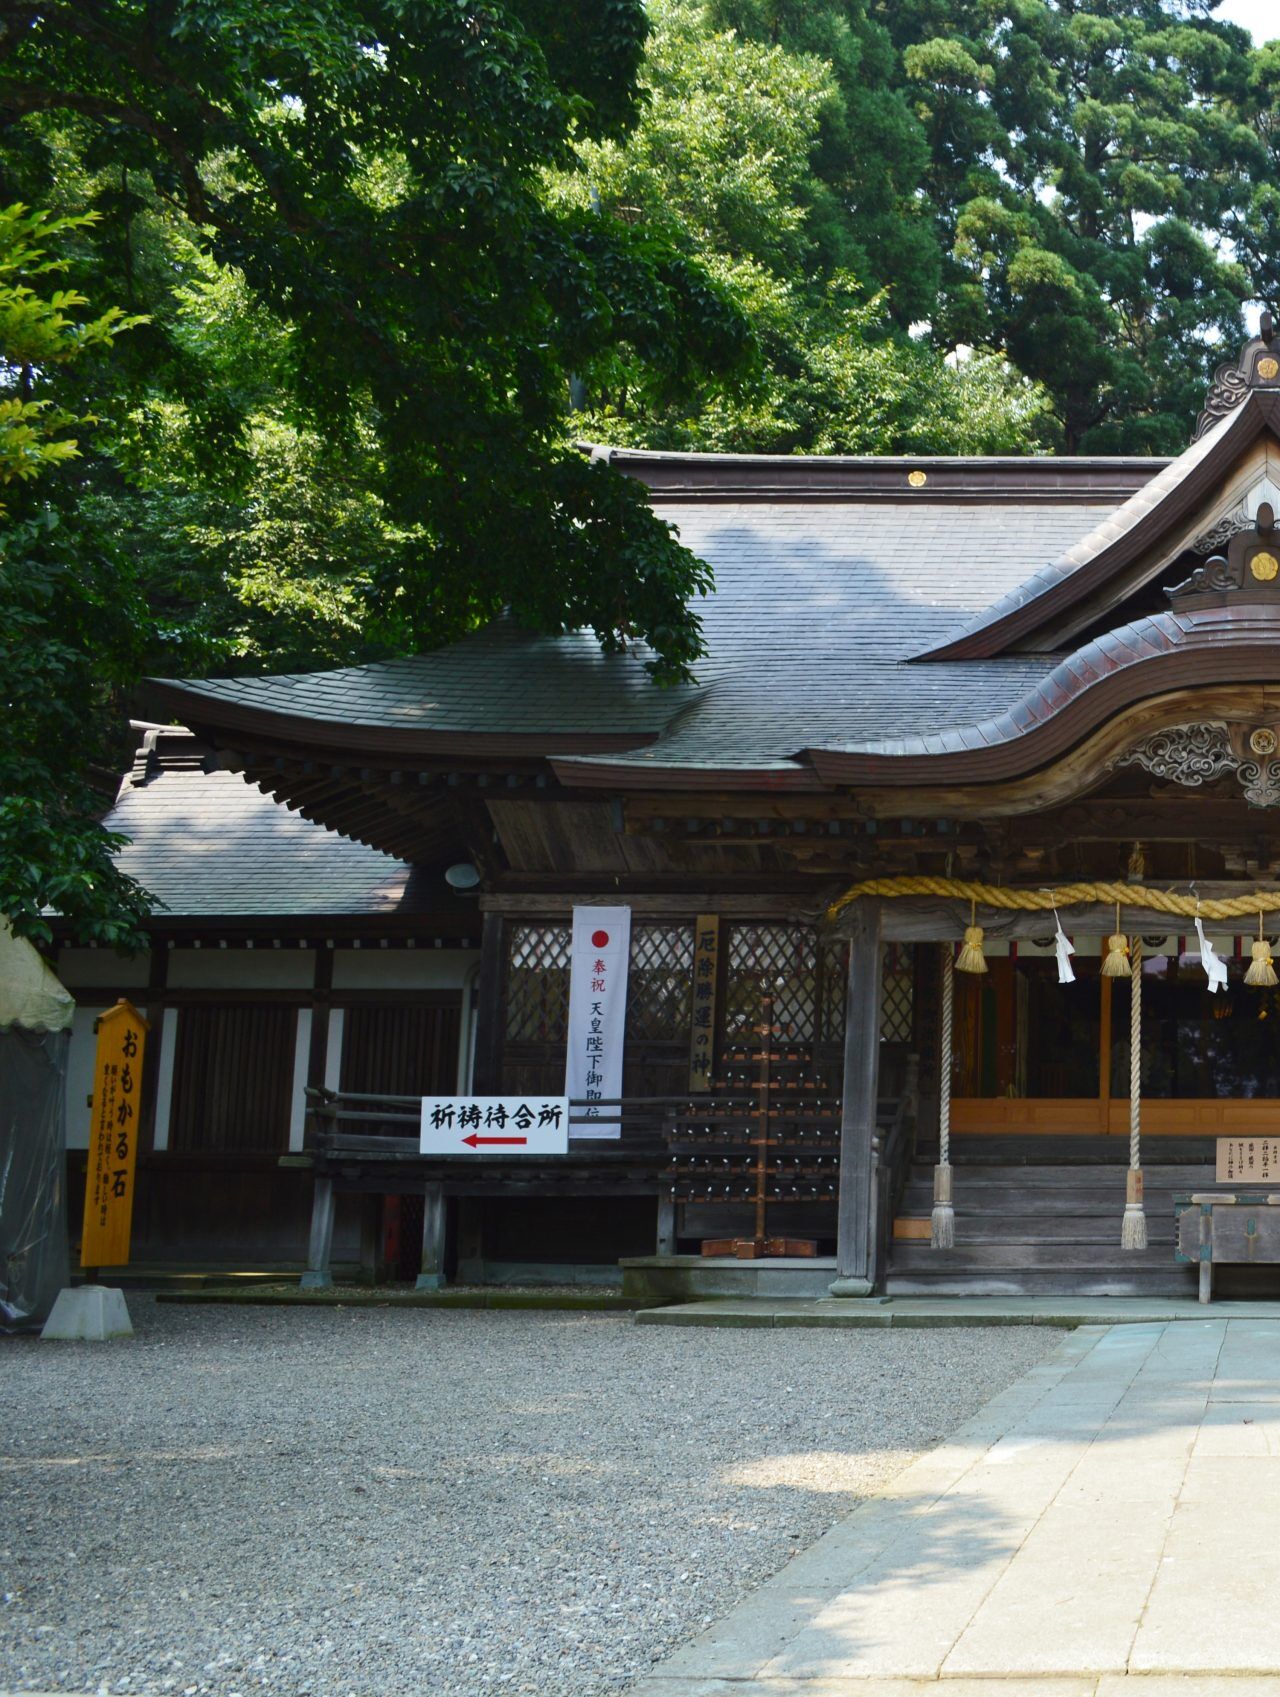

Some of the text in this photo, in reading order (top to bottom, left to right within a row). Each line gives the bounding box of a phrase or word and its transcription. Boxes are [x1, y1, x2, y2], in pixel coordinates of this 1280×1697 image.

[590, 958, 607, 992] 奉祝
[693, 930, 715, 1076] 厄除勝運の神
[111, 1029, 138, 1198] おもかる石
[430, 1103, 563, 1131] 祈祷待合所
